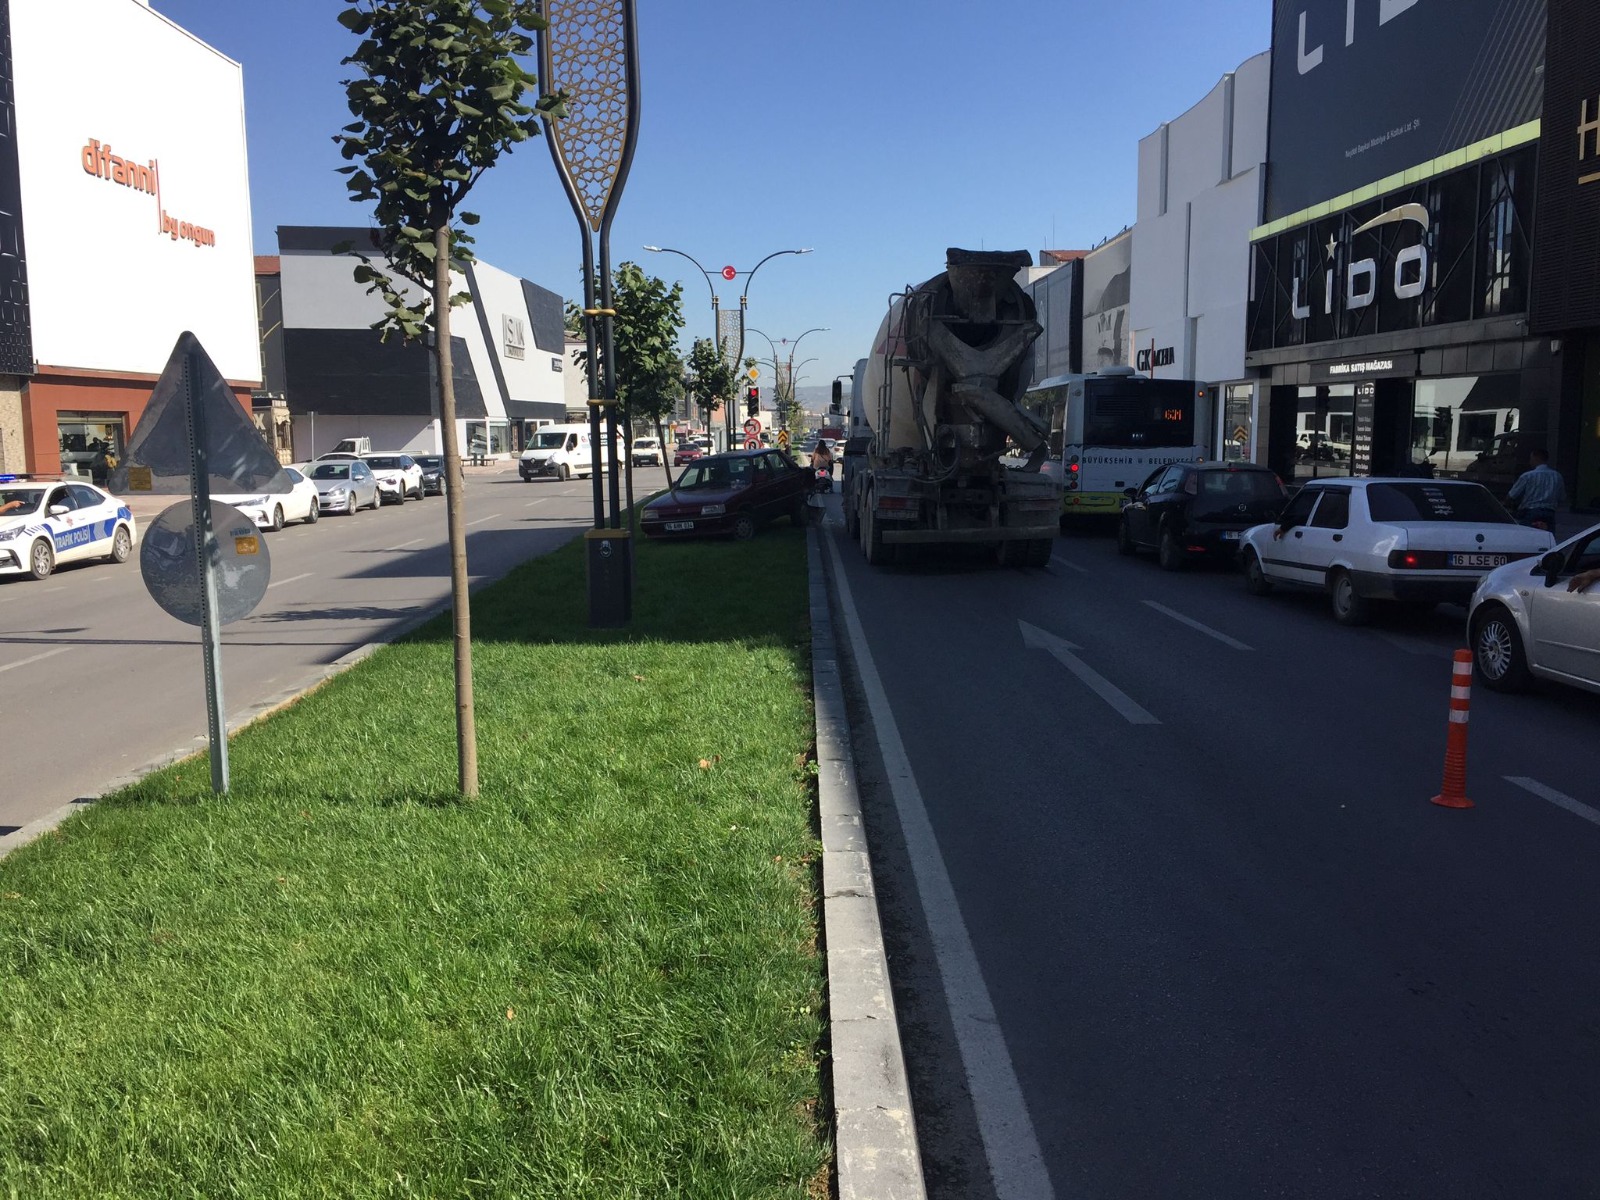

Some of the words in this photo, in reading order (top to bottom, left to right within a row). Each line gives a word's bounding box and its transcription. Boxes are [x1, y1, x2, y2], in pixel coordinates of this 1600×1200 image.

[82, 137, 157, 196] difanni
[162, 209, 179, 241] by
[179, 221, 216, 248] ongun
[1329, 363, 1350, 374] FABRİKA
[1350, 362, 1365, 373] SATIŞ
[1454, 555, 1464, 565] 16
[1468, 556, 1491, 566] LSE
